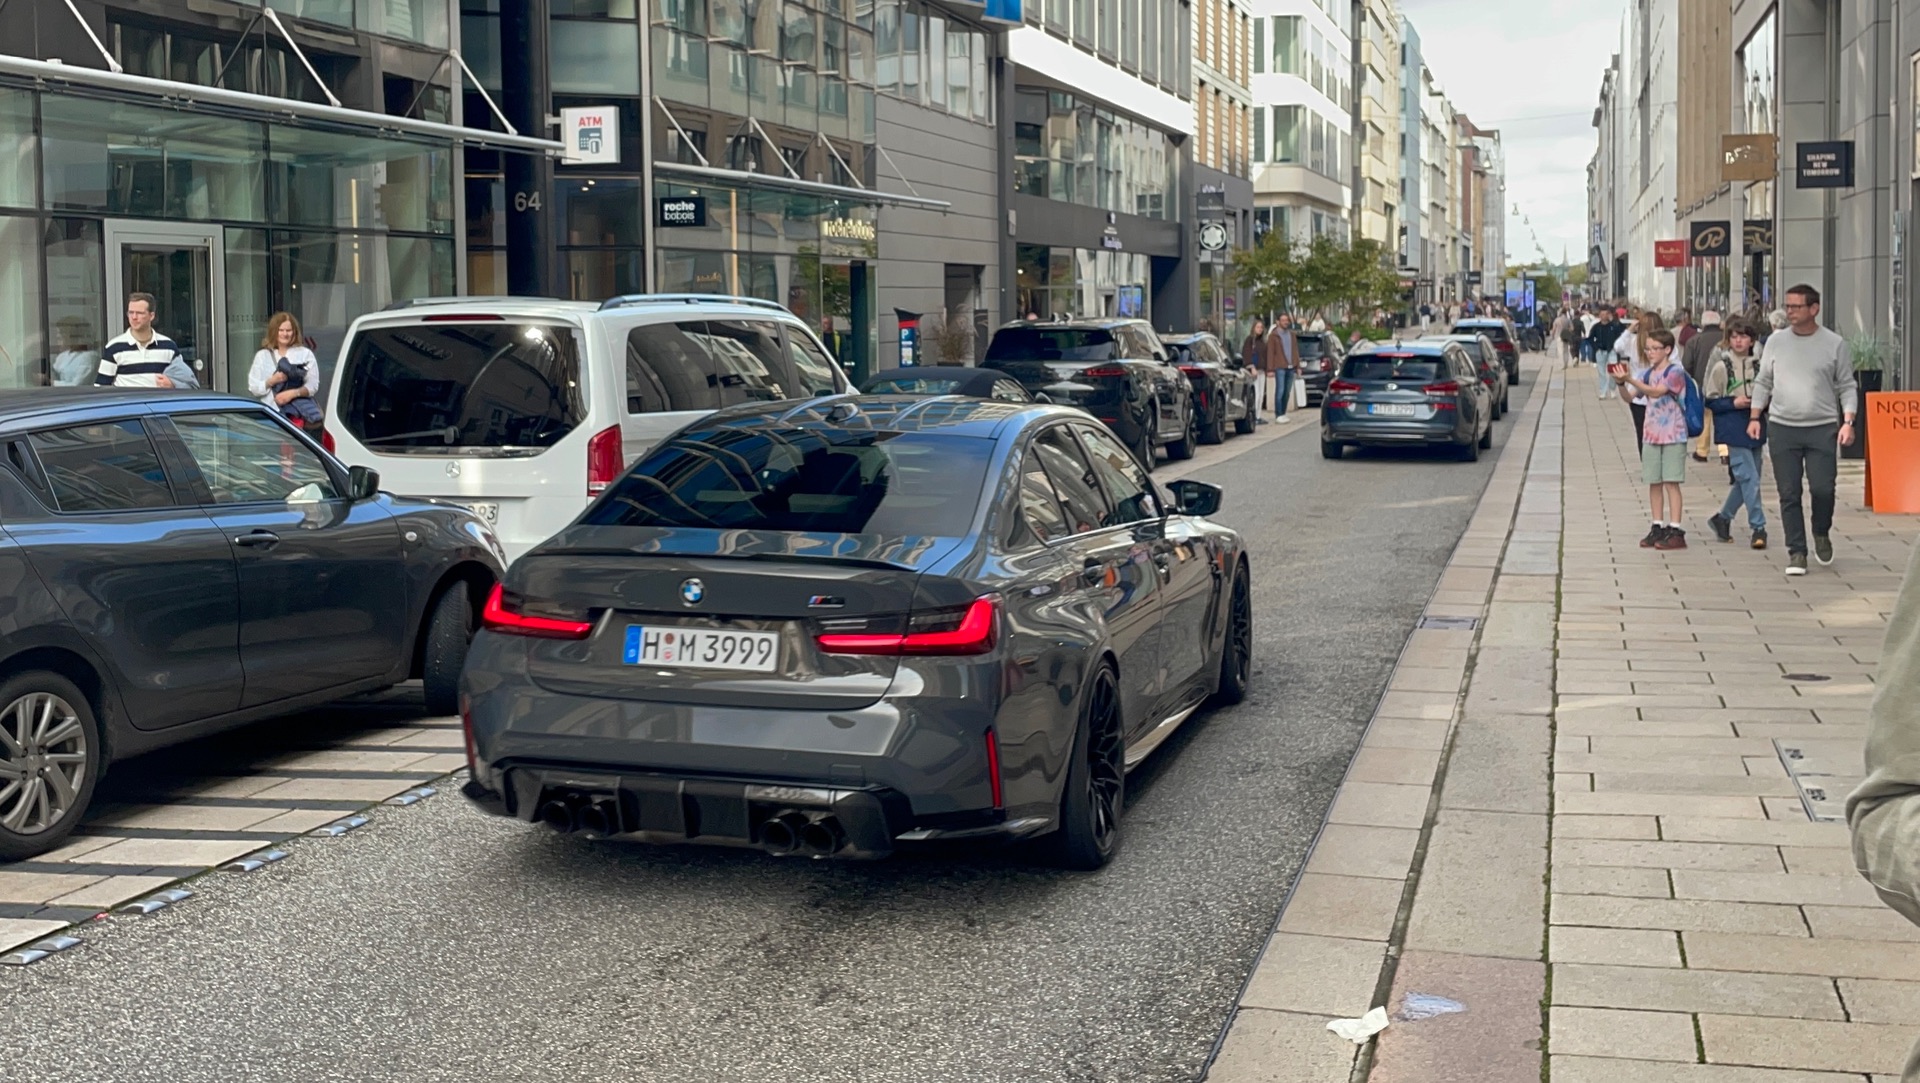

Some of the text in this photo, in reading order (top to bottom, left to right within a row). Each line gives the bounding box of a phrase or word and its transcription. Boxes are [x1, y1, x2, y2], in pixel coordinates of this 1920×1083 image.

[578, 116, 603, 127] ATM
[1806, 153, 1836, 162] SHAPING
[1802, 168, 1840, 177] TOMORROW
[514, 191, 542, 212] 64
[664, 200, 696, 211] roche
[664, 211, 696, 221] bobois
[642, 632, 772, 665] H M 3999
